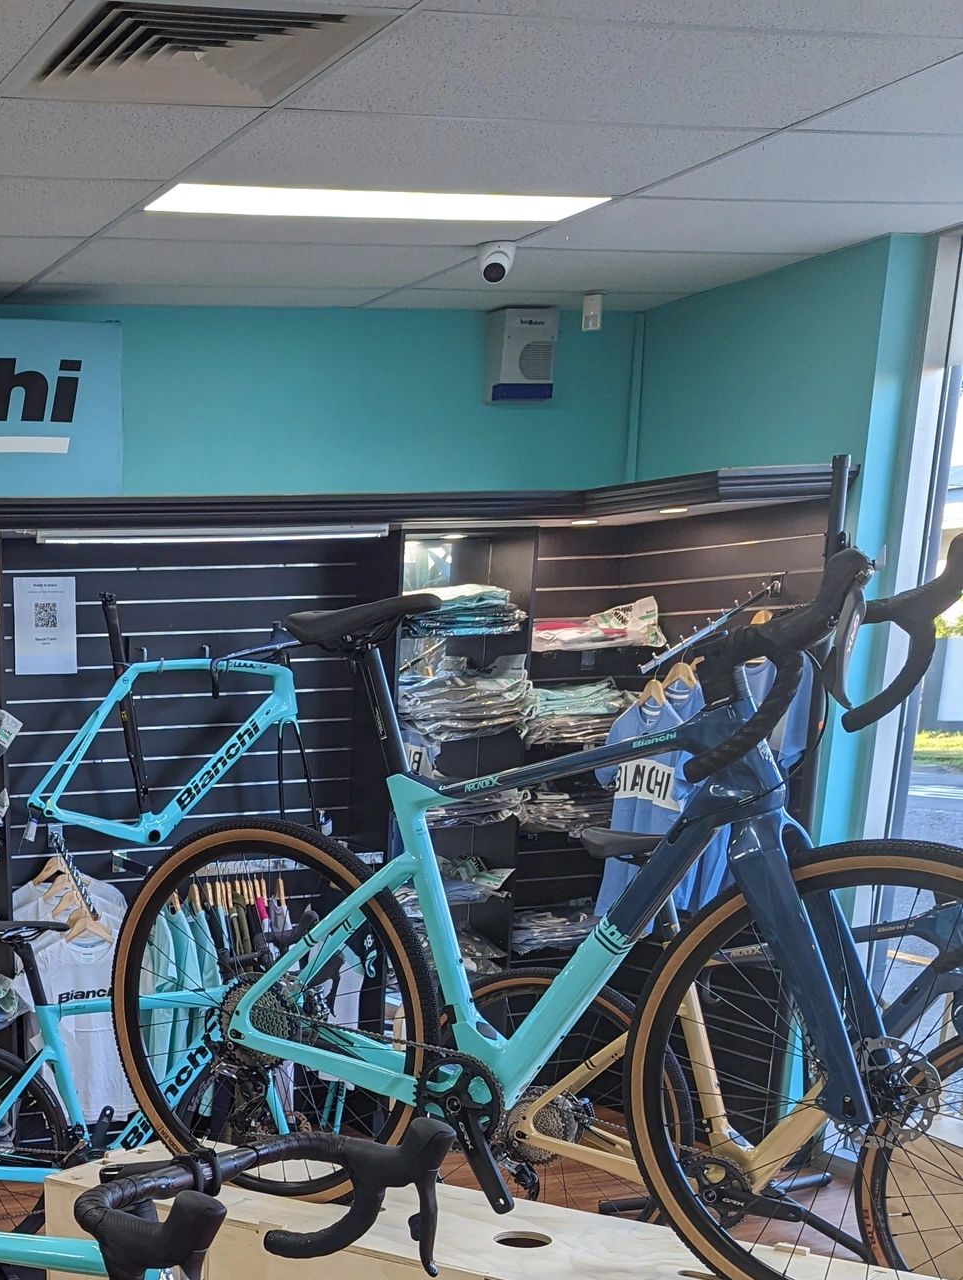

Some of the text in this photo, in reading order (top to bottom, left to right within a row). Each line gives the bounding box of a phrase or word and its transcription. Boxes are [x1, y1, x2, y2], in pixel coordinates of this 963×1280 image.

[632, 731, 677, 749] Bianchi
[175, 718, 261, 812] Bianchi
[458, 1121, 473, 1150] GRX
